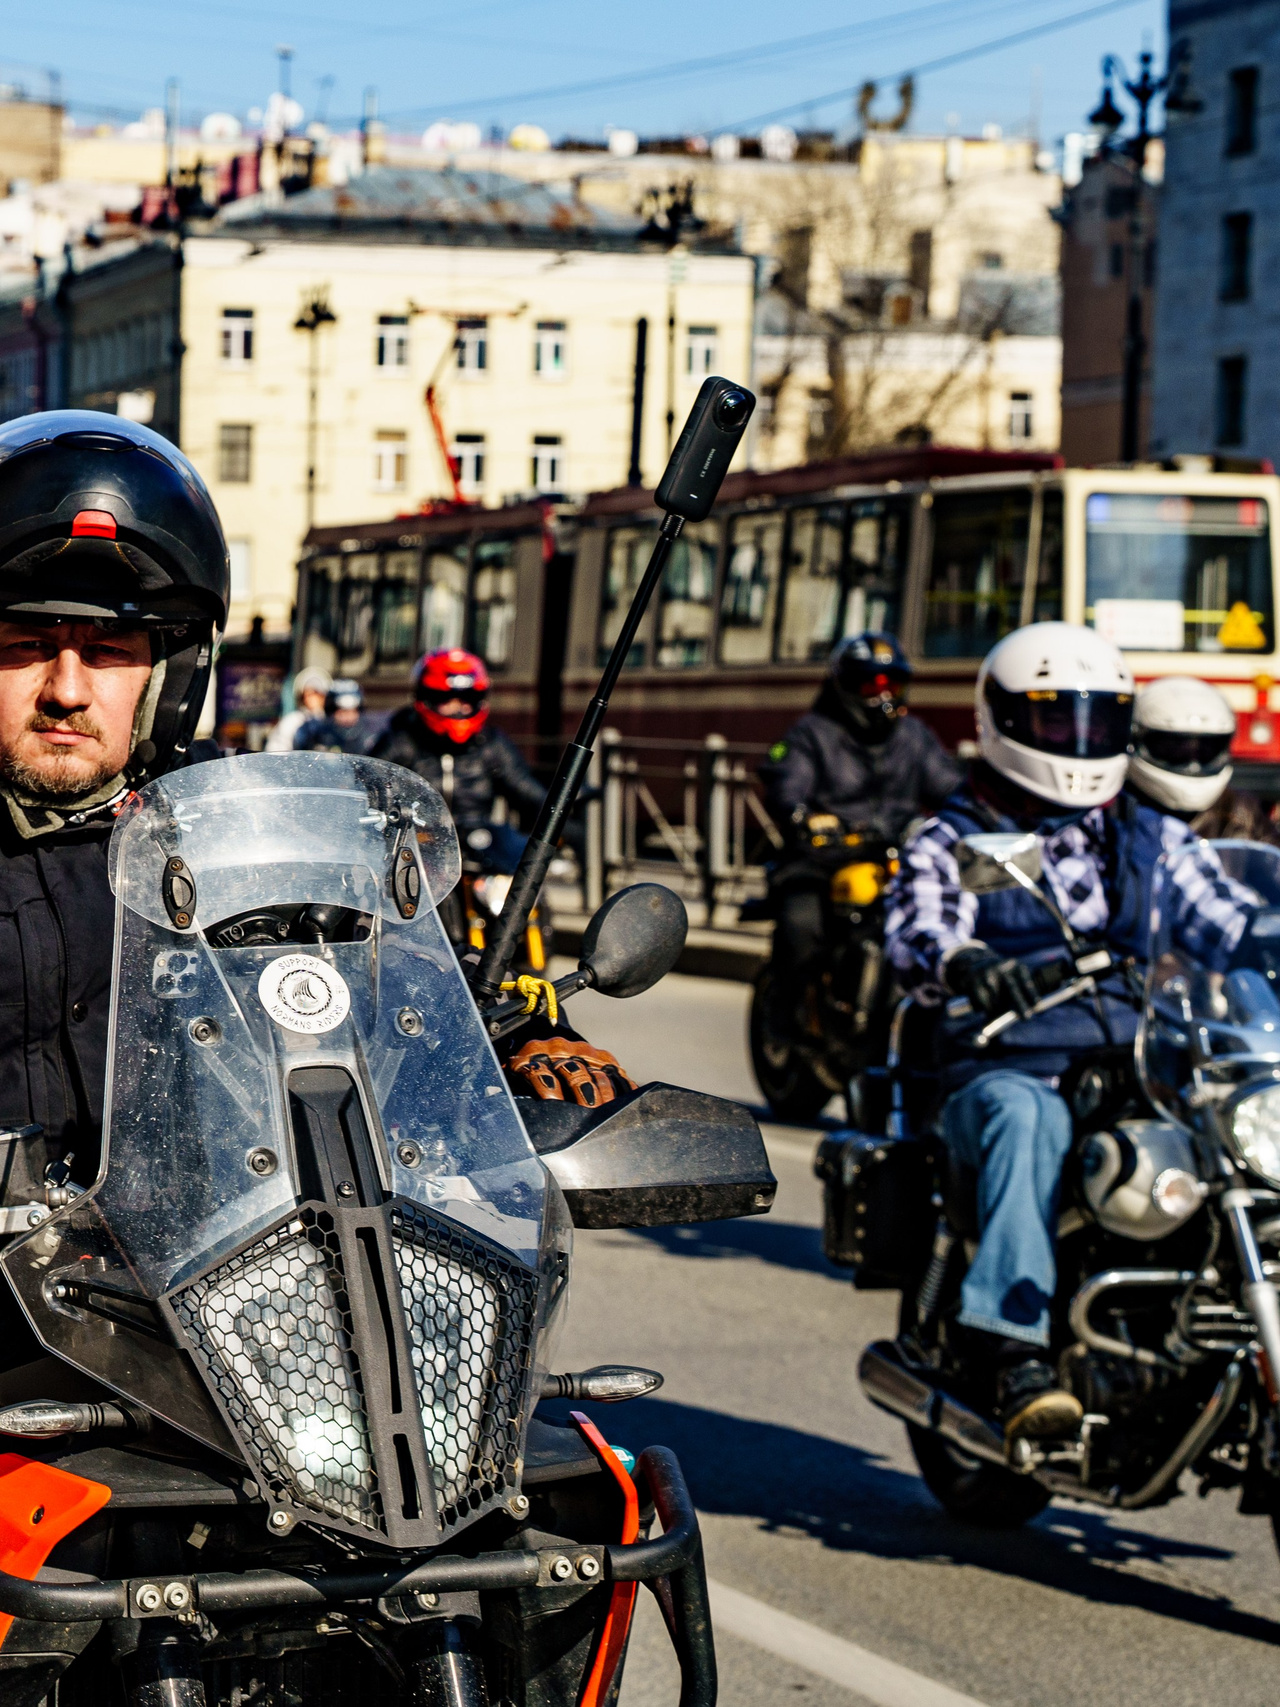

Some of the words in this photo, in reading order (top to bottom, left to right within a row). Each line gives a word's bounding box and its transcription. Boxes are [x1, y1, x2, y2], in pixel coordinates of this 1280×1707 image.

[277, 957, 320, 971] SUPPORT
[270, 1004, 312, 1030] NORMANS
[316, 1003, 344, 1029] RIDERS
